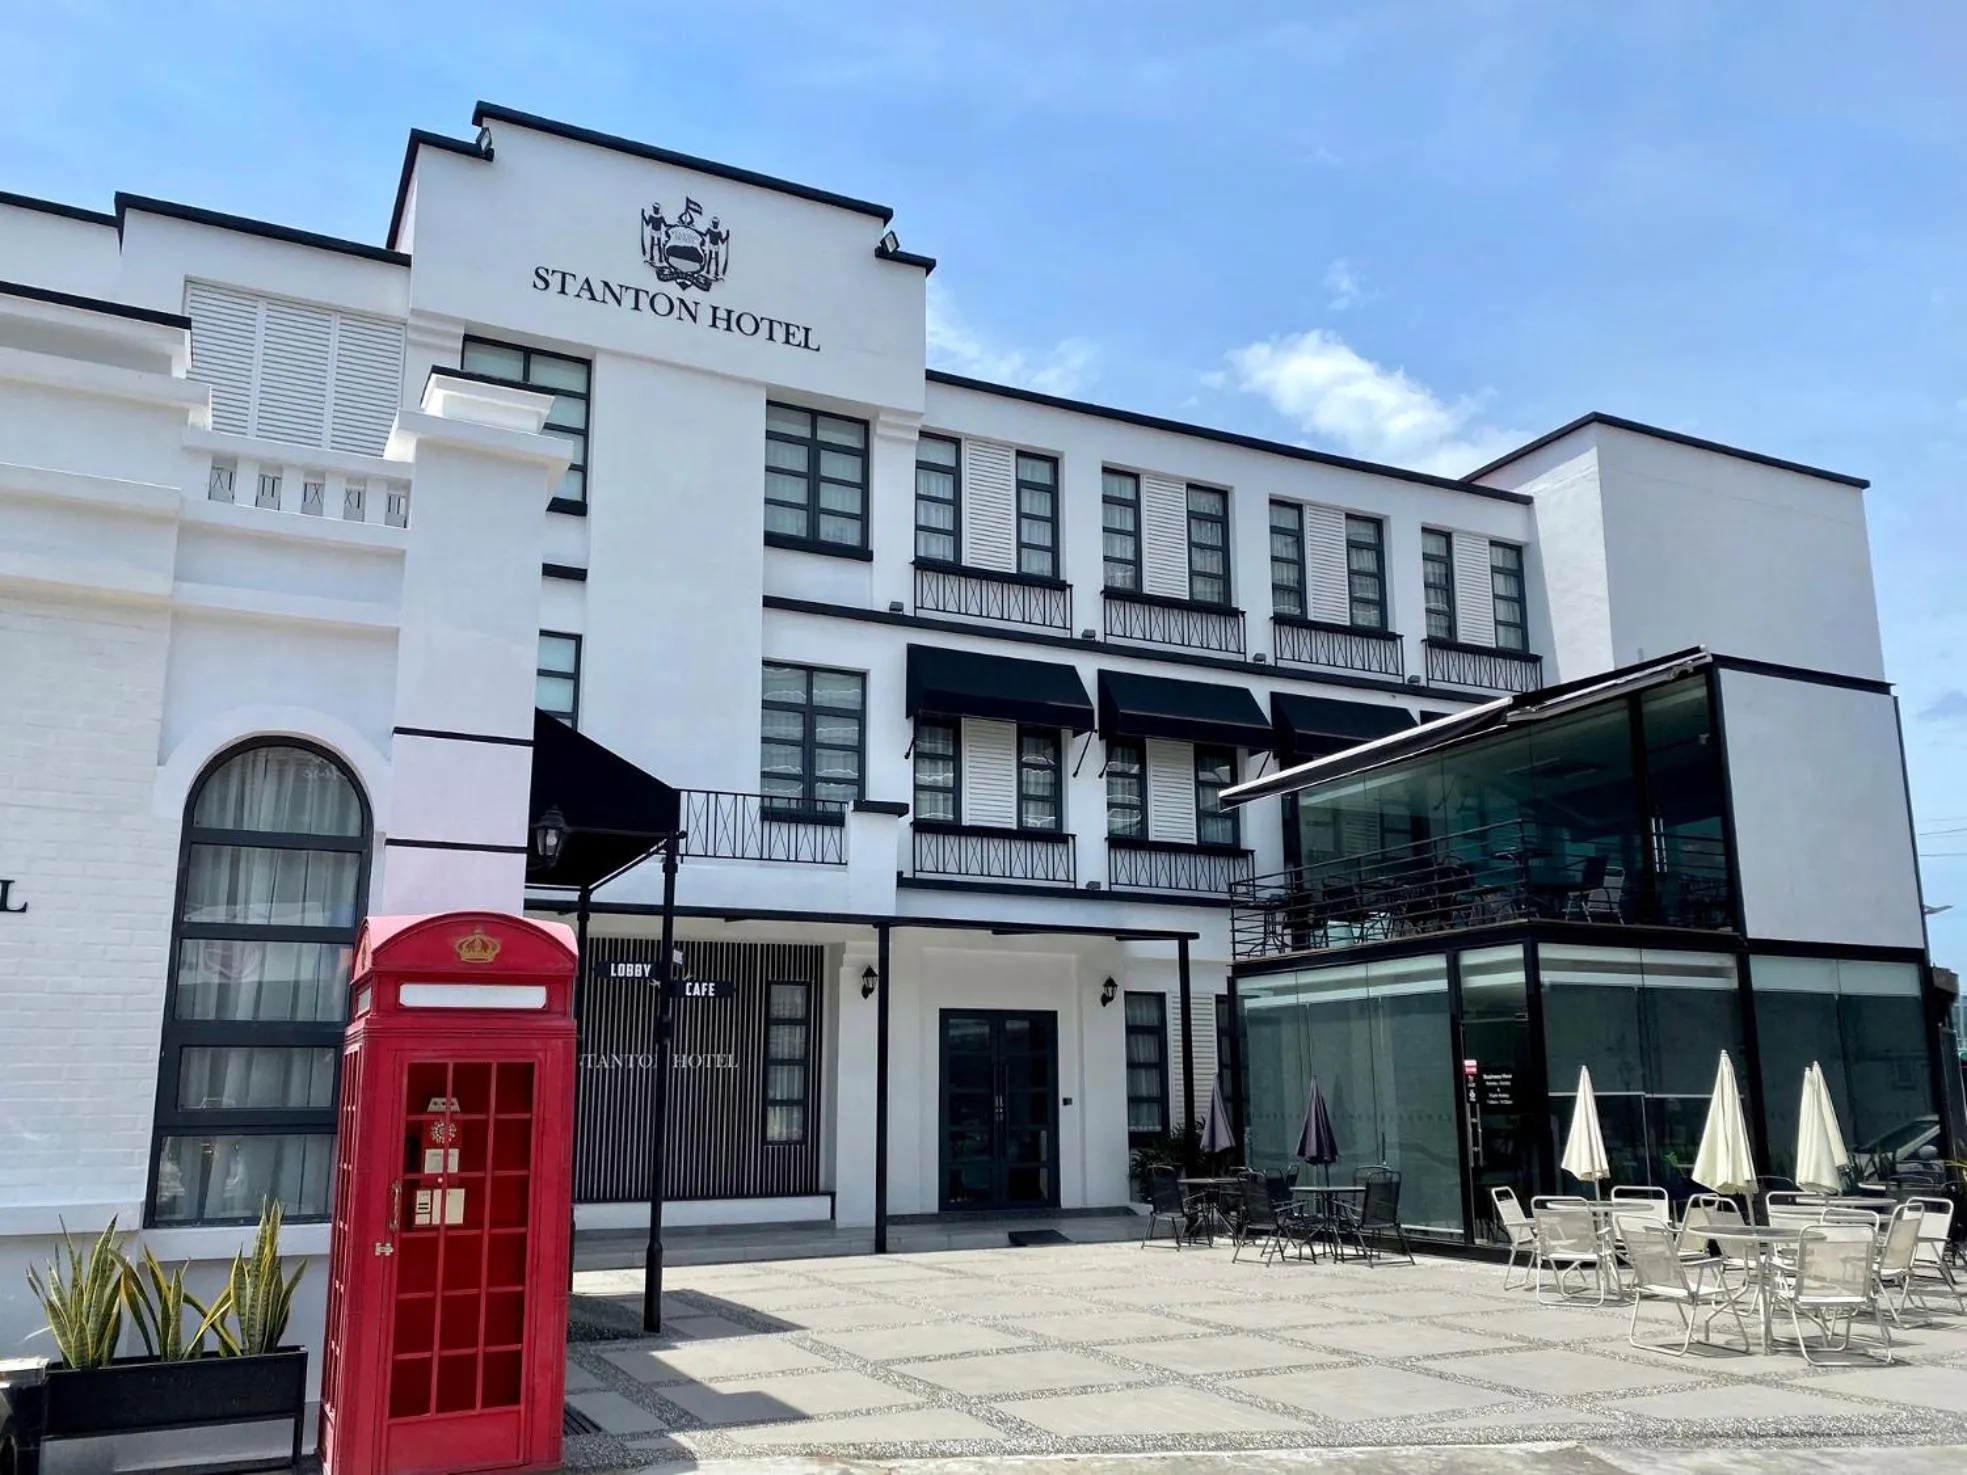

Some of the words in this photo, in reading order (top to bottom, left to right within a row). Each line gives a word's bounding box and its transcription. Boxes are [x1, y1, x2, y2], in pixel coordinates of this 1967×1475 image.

[532, 265, 700, 324] STANTON
[708, 304, 821, 352] HOTEL
[610, 962, 651, 978] LOBBY
[685, 981, 716, 997] CAFE
[579, 1053, 658, 1069] TANTO
[672, 1053, 740, 1069] HOTEL
